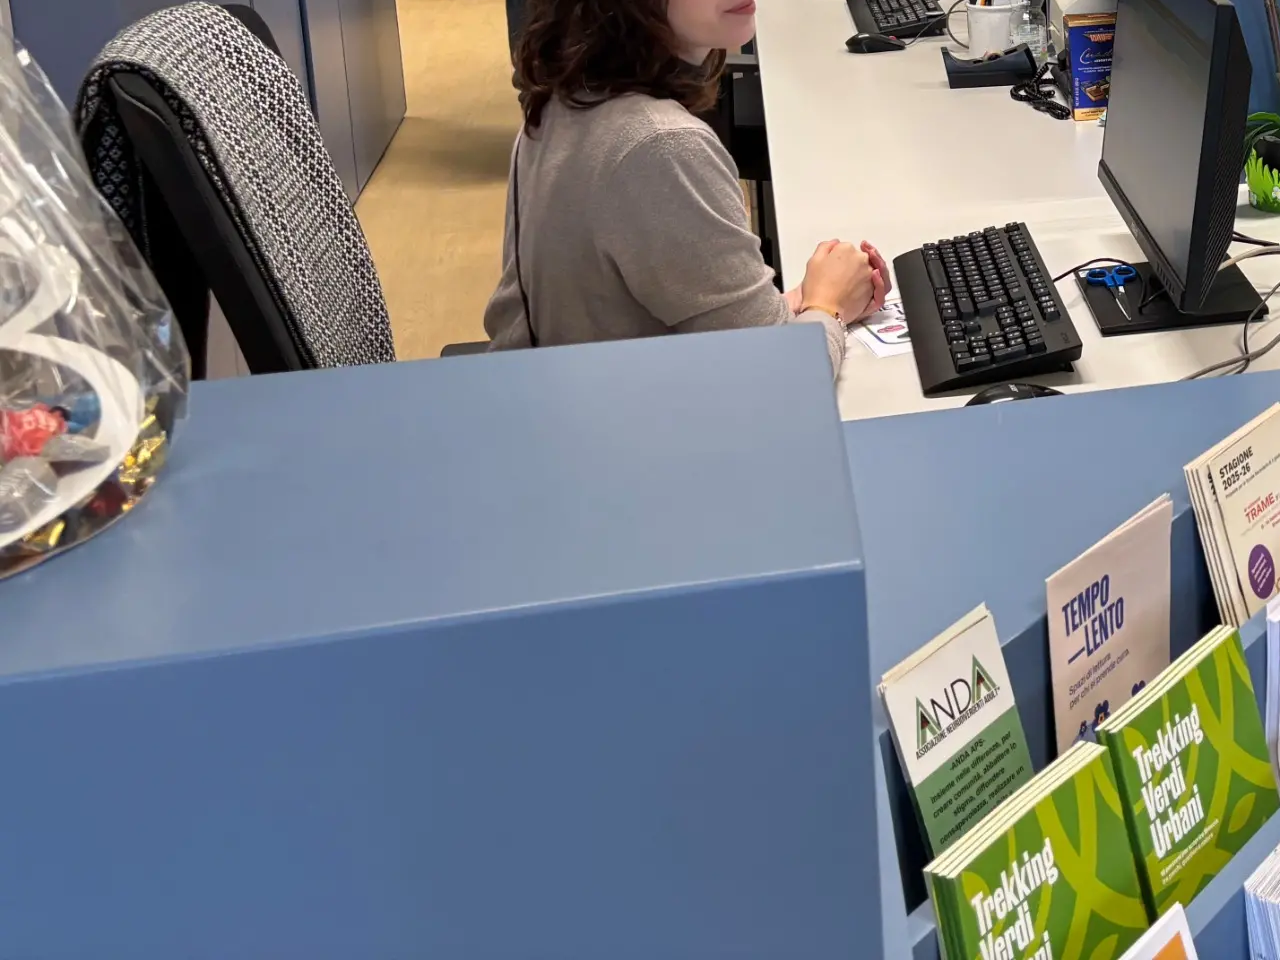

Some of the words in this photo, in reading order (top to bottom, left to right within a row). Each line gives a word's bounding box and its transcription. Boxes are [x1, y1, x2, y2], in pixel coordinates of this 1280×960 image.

[1219, 446, 1254, 479] STAGIONE
[1222, 462, 1251, 491] 2025-26
[1245, 492, 1276, 523] TRAME
[1062, 574, 1109, 637] TEMPO
[916, 654, 998, 749] ANDA
[1069, 673, 1087, 696] Spazi
[1086, 668, 1093, 680] di
[1092, 653, 1111, 675] lettura
[1069, 695, 1081, 710] per
[1081, 683, 1092, 699] chi
[1090, 678, 1096, 690] si
[1095, 660, 1117, 683] prende
[1116, 648, 1130, 666] cura
[915, 729, 948, 760] ASSOCIAZIONE
[946, 699, 985, 735] NEURODIVERGENTI
[956, 767, 971, 783] nelle
[970, 742, 1002, 769] differenze,
[1001, 731, 1011, 746] per
[1132, 703, 1204, 786] Trekking
[933, 798, 954, 819] creare
[953, 772, 983, 800] comunità,
[983, 748, 1010, 774] abbattere
[939, 799, 989, 845] consapevolezza,
[988, 773, 1016, 800] realizzare
[1014, 766, 1025, 777] un
[953, 794, 976, 817] stigma,
[975, 766, 1005, 796] diffondere
[1141, 755, 1186, 821] Verdi
[1150, 784, 1205, 860] Urbani
[971, 837, 1059, 936] Trekking
[979, 900, 1035, 960] Verdi
